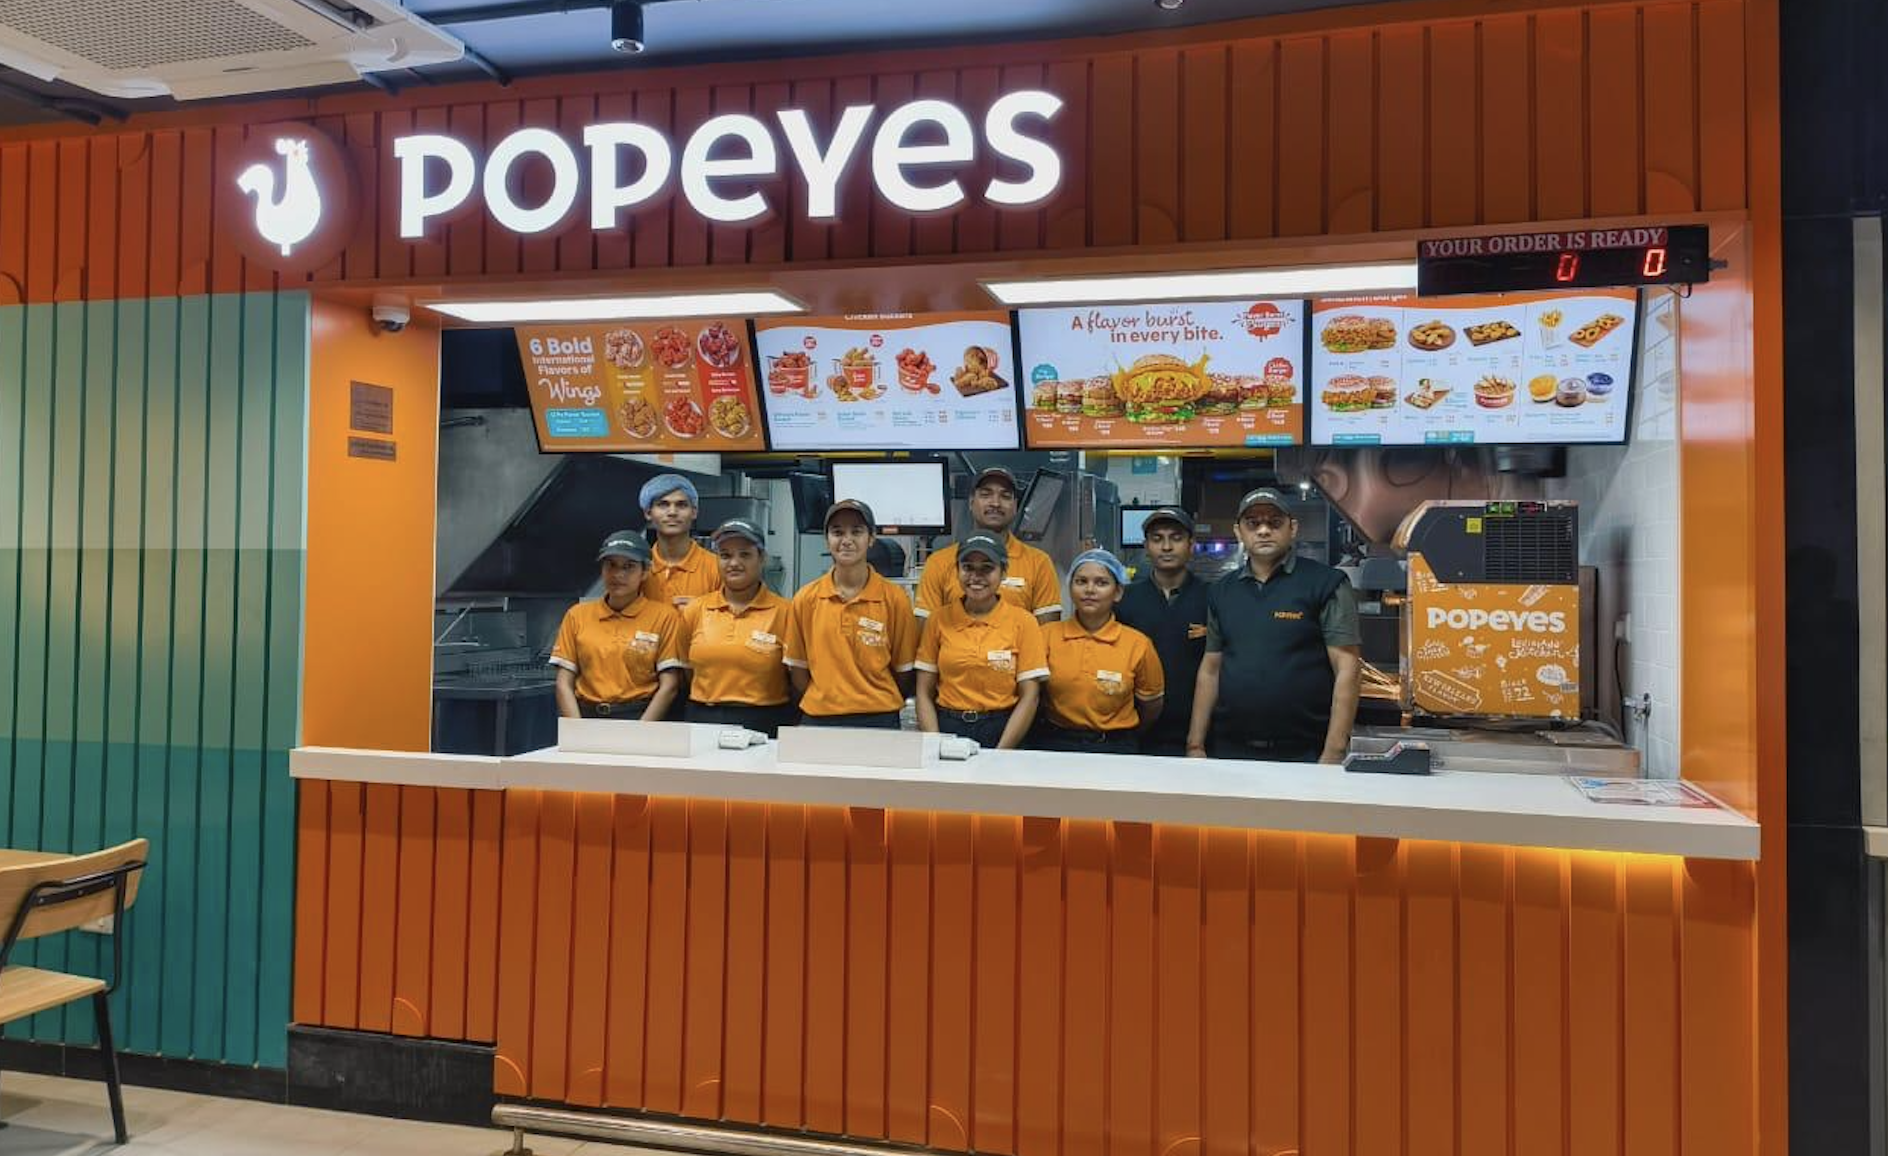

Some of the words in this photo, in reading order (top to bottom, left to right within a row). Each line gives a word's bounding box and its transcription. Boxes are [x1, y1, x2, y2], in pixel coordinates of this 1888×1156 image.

[1427, 236, 1483, 256] YOUR
[1488, 233, 1562, 254] ORDER
[1566, 231, 1586, 249] IS
[1590, 228, 1665, 248] READY
[1556, 254, 1578, 281] 0
[1071, 316, 1083, 330] A
[1087, 311, 1140, 334] flavor
[1145, 310, 1195, 328] burst
[529, 338, 543, 356] 6
[546, 336, 594, 355] Bold
[1111, 329, 1126, 343] in
[1130, 330, 1179, 344] every
[1184, 326, 1224, 341] bite.
[532, 354, 595, 365] International
[538, 365, 579, 375] Flavors
[580, 364, 592, 375] of
[538, 377, 602, 406] Wings
